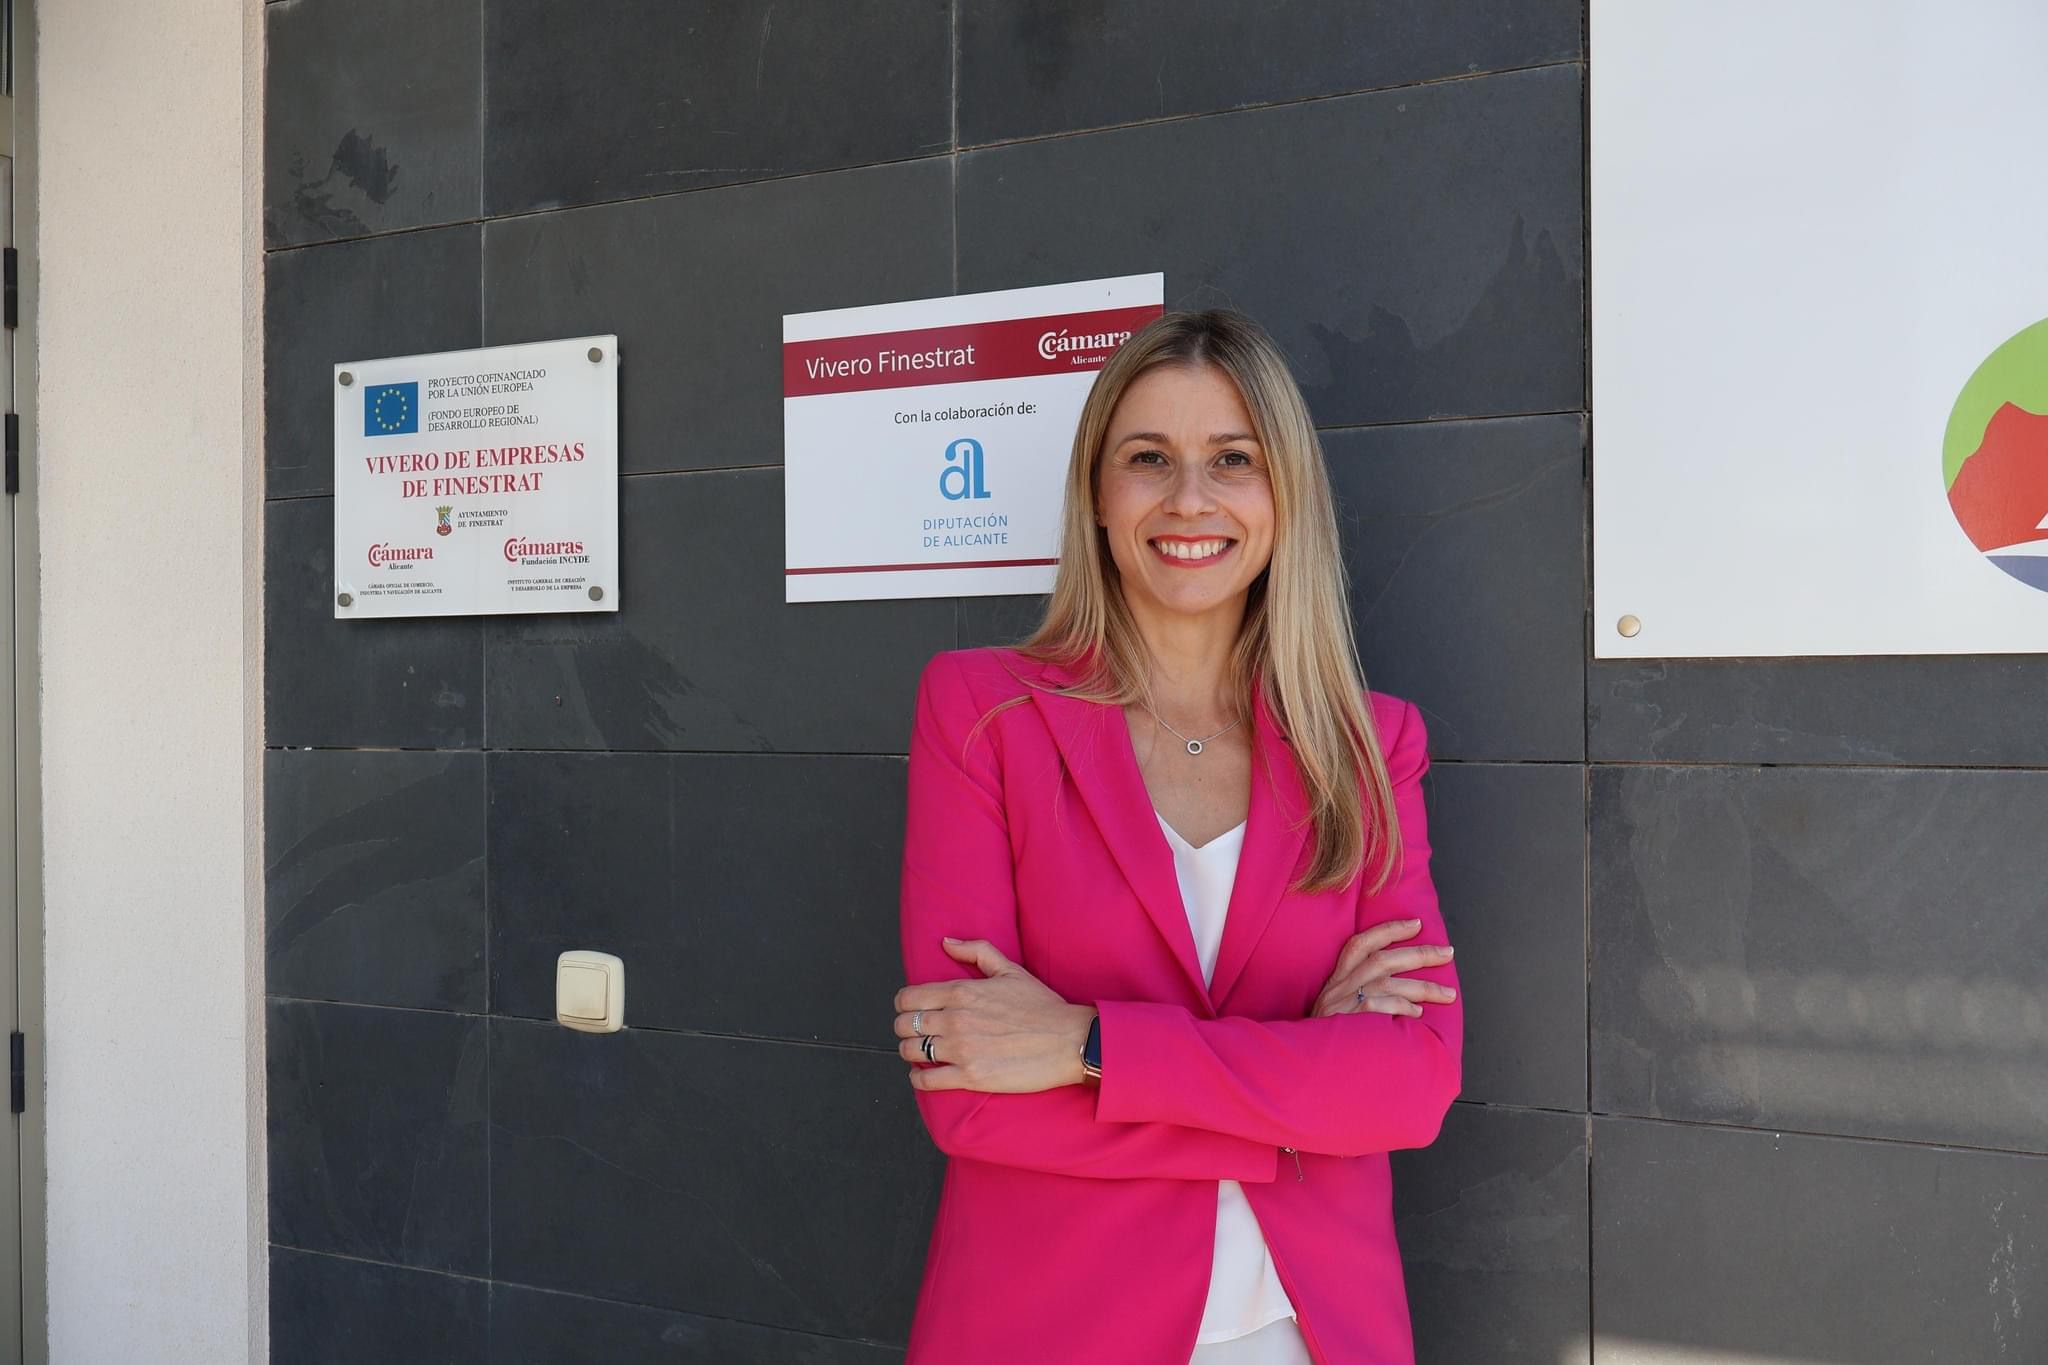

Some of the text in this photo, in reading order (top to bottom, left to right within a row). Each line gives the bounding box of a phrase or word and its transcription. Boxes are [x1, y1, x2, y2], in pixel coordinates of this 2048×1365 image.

[806, 344, 975, 379] Vivero Finestrat
[1071, 355, 1107, 365] Alicante
[428, 368, 546, 388] PROYECTO COFINANCIADO
[428, 382, 534, 399] POR LA UNIÓN EUROPEA
[428, 404, 520, 421] (FONDO EUROPEO DE
[894, 402, 1037, 424] Con la colaboración de:
[428, 415, 539, 432] DESARROLLO REGIONAL)
[366, 442, 585, 474] VIVERO DE EMPRESAS
[402, 472, 543, 498] DE FINESTRAT
[457, 510, 508, 519] AYUNTAMIENTO
[923, 513, 1008, 530] DIPUTACIÓN
[457, 519, 504, 528] DE FINESTRAT
[923, 533, 1009, 548] DE ALICANTE
[521, 555, 590, 566] Fundación INCYDE
